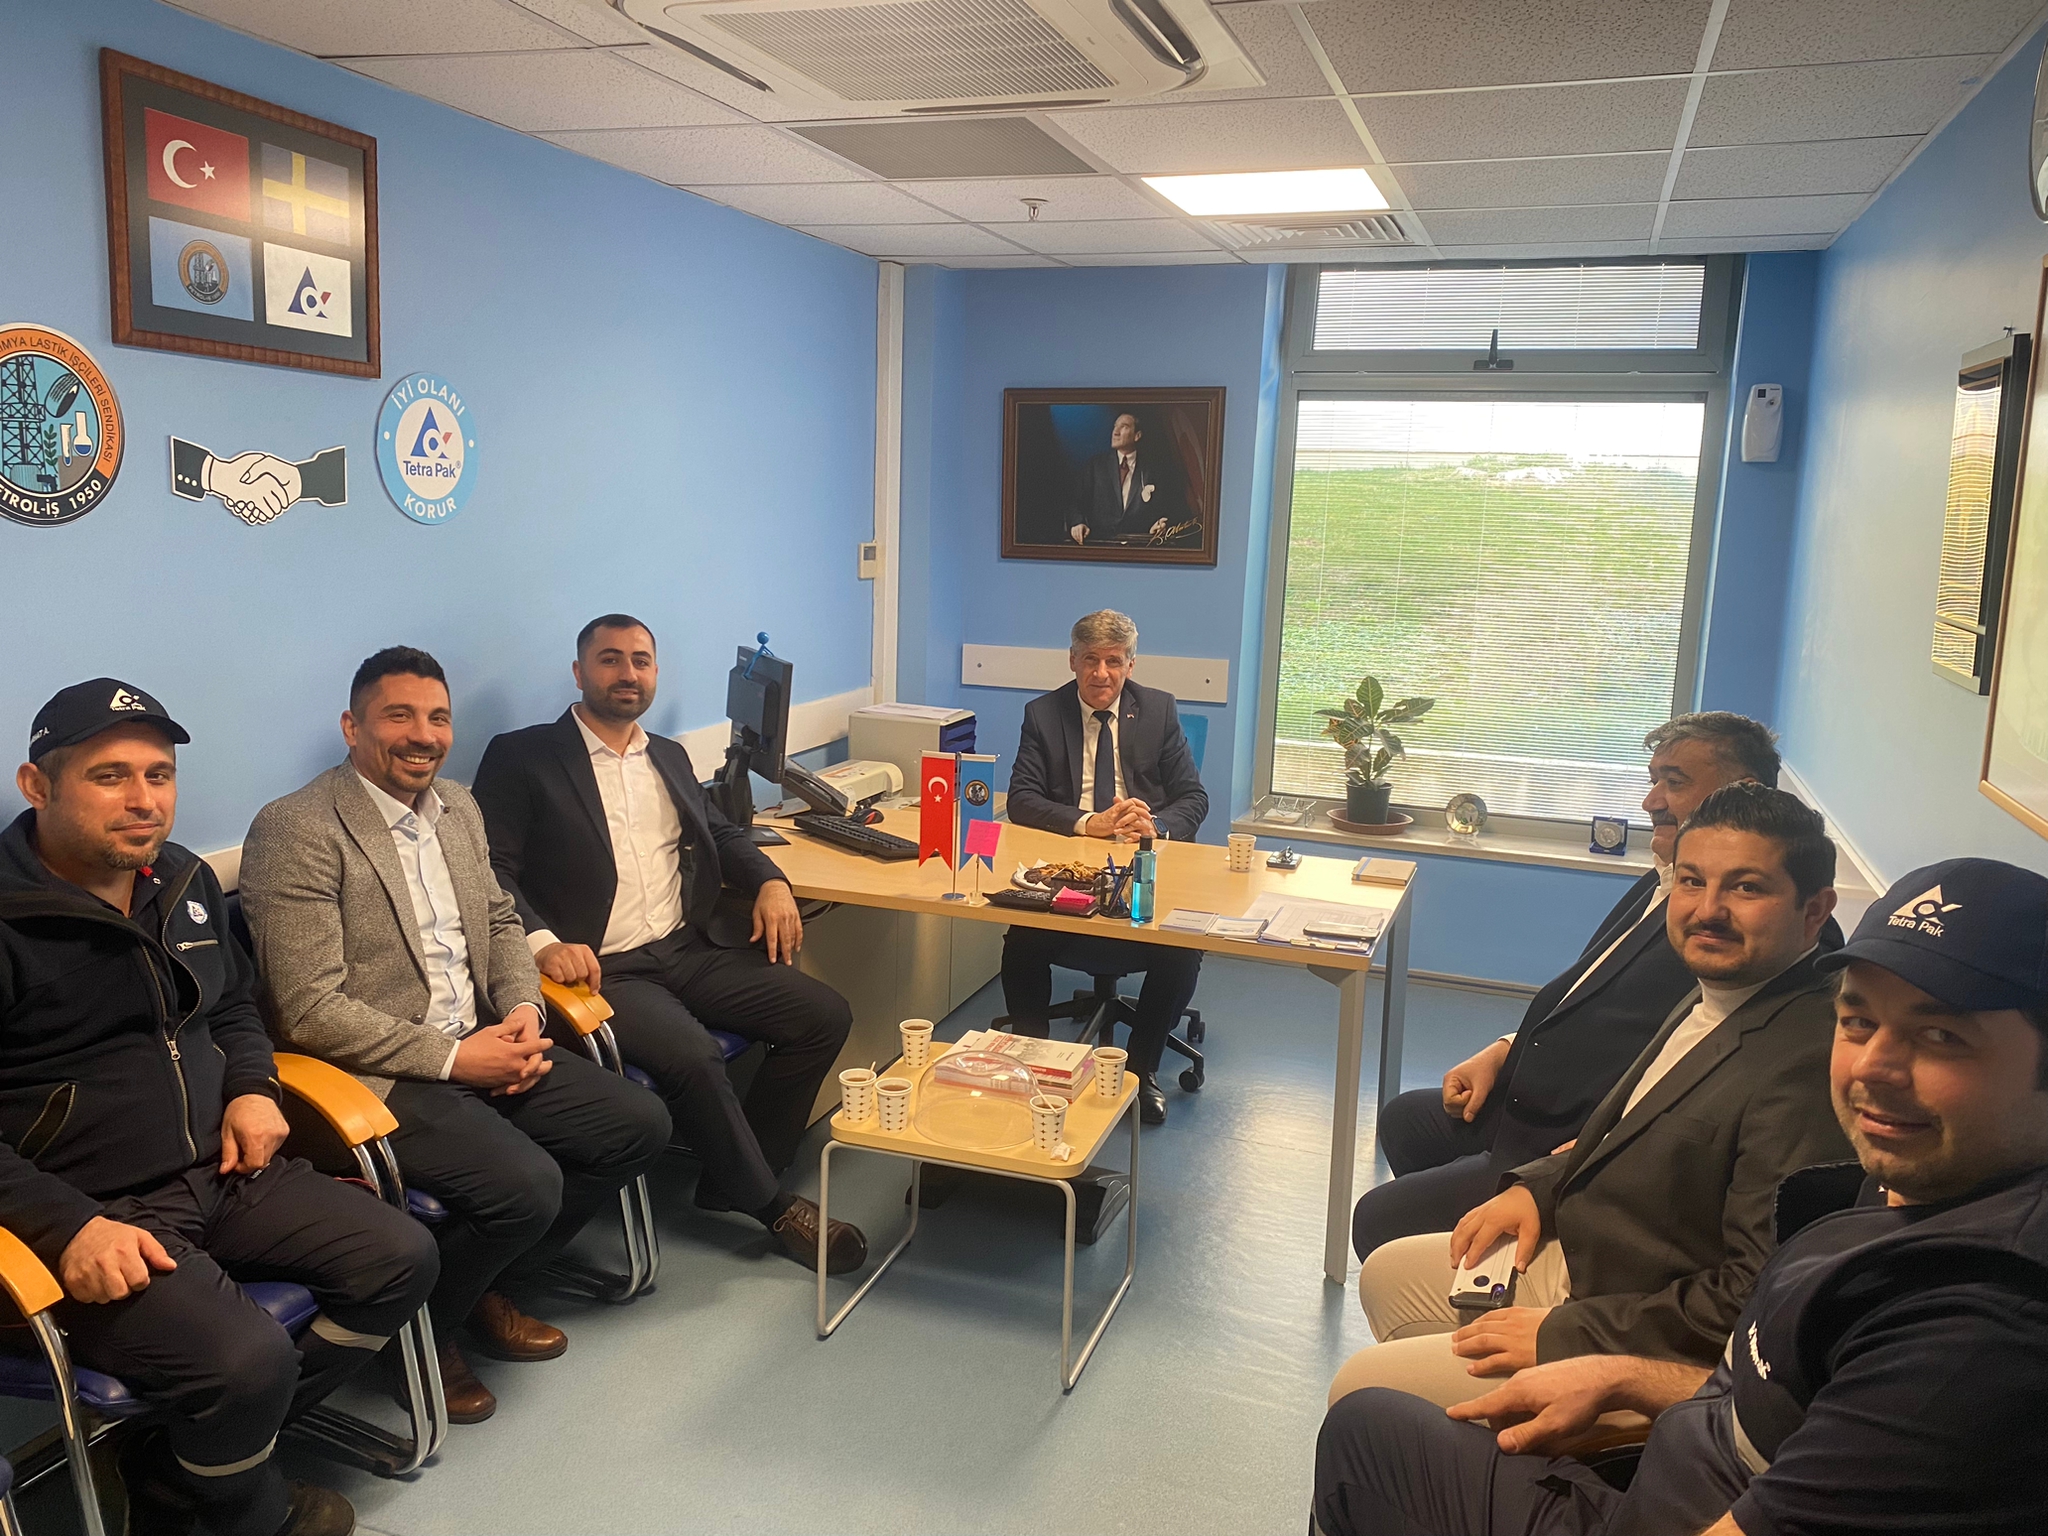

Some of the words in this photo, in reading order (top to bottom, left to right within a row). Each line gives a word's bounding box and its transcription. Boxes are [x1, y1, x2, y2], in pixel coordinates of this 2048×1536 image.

[30, 337, 68, 357] LASTİK
[391, 379, 414, 410] İYİ
[418, 378, 465, 416] OLANI
[403, 460, 433, 477] Tetra
[69, 479, 102, 509] 1950
[404, 493, 457, 519] KORUR
[1887, 915, 1917, 929] Tetra
[1917, 920, 1945, 938] Pak
